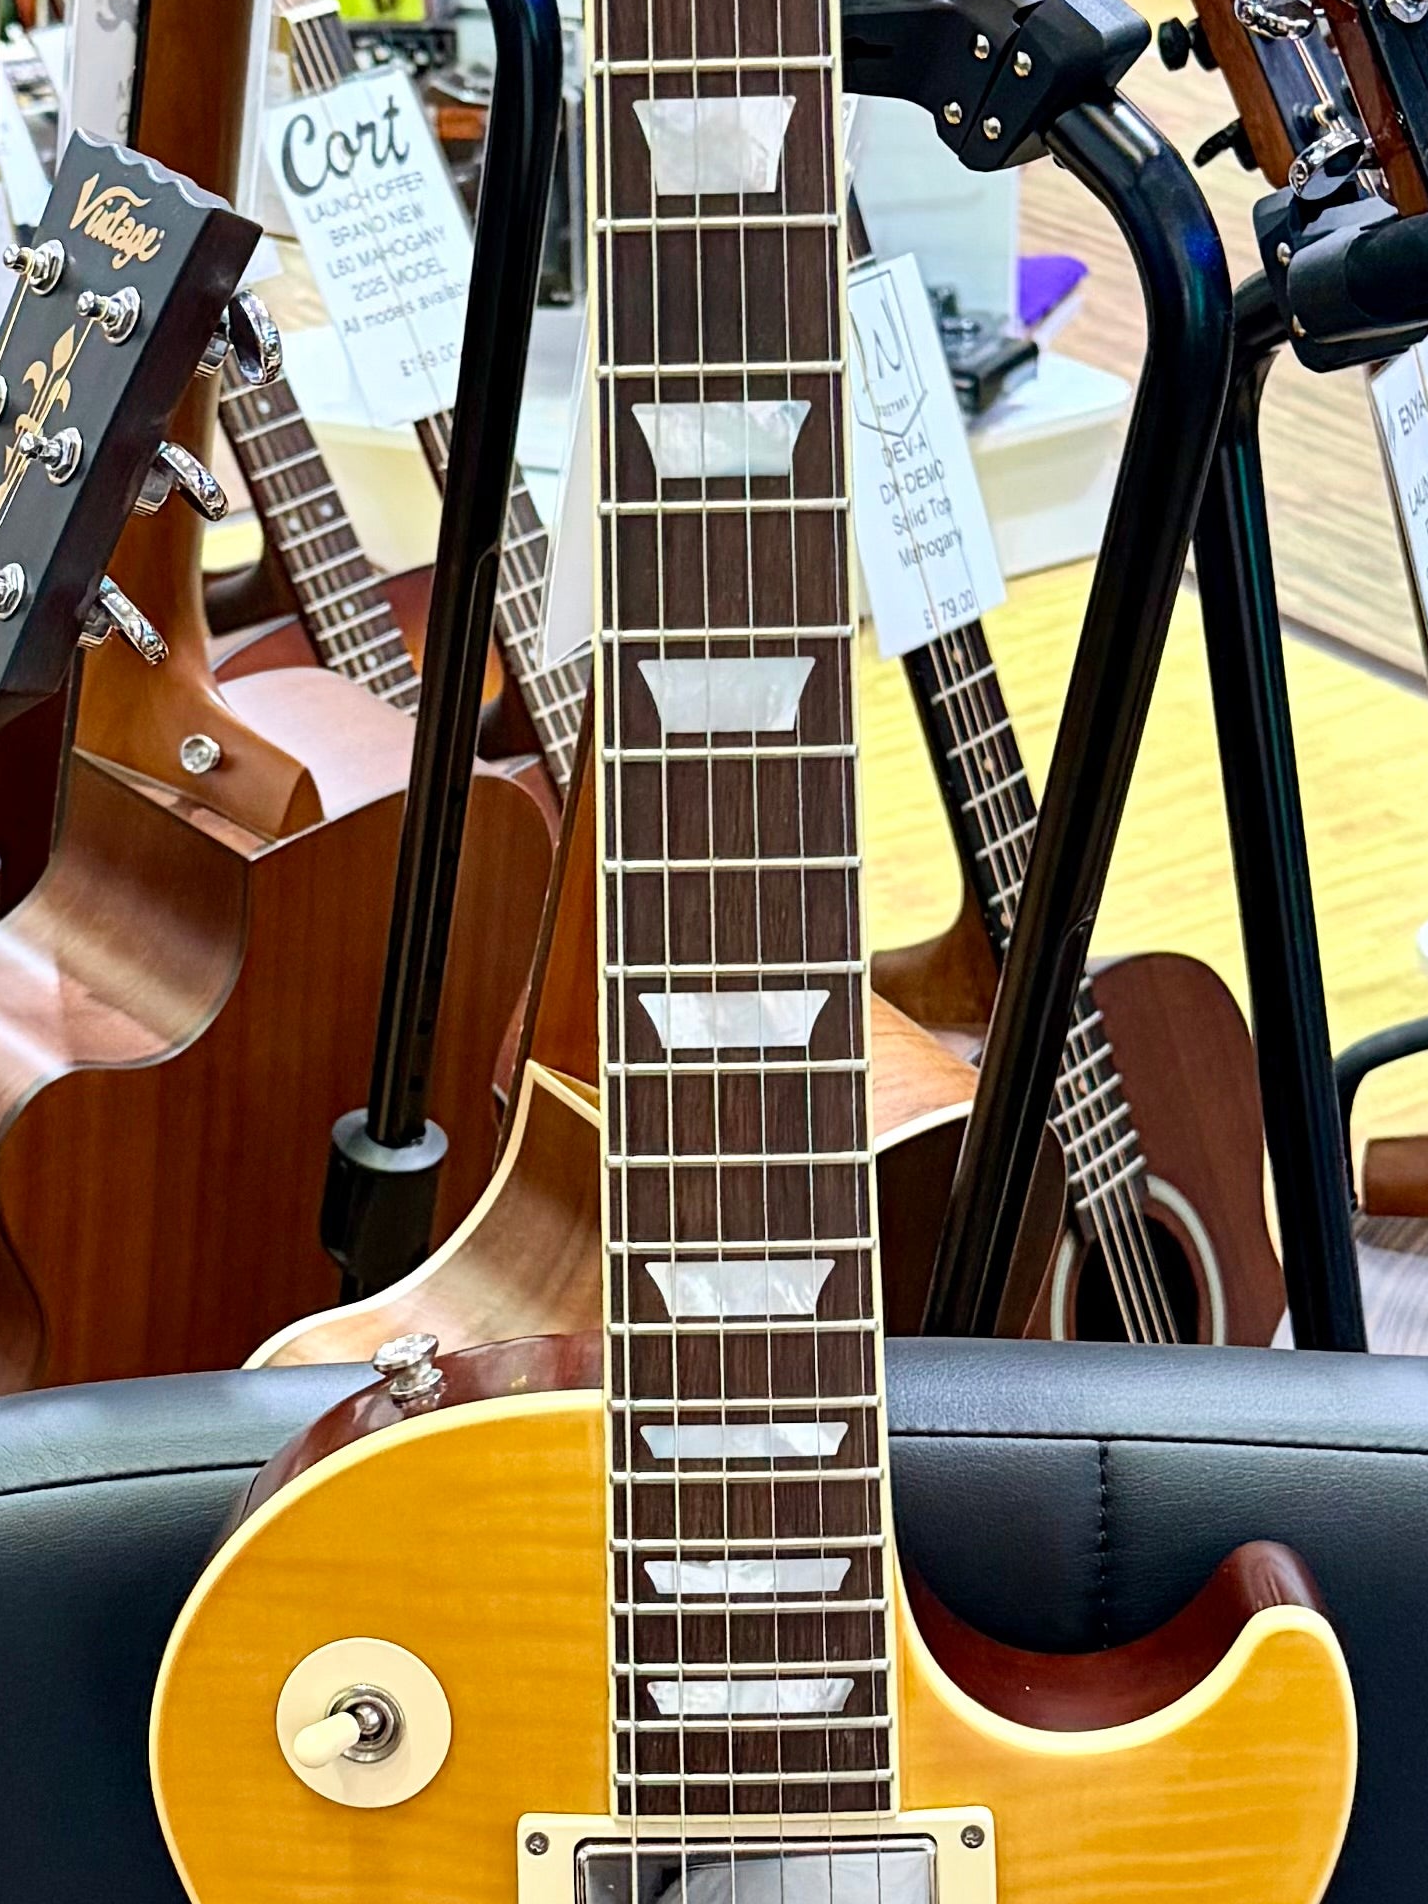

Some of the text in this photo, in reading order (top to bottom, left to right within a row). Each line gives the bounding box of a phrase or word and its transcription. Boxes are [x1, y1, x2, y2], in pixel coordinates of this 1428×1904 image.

[281, 94, 410, 198] Cort
[303, 170, 425, 225] LAUNCH OFFER
[69, 172, 162, 270] Vintage
[328, 202, 426, 248] BRAND NEW
[358, 223, 448, 268] MAHOGANY
[390, 255, 448, 288] MODEL
[363, 300, 415, 330] models
[418, 280, 468, 311] availab
[1398, 395, 1427, 437] ENYA
[891, 495, 954, 538] Solid Top
[924, 588, 975, 631] £79.00
